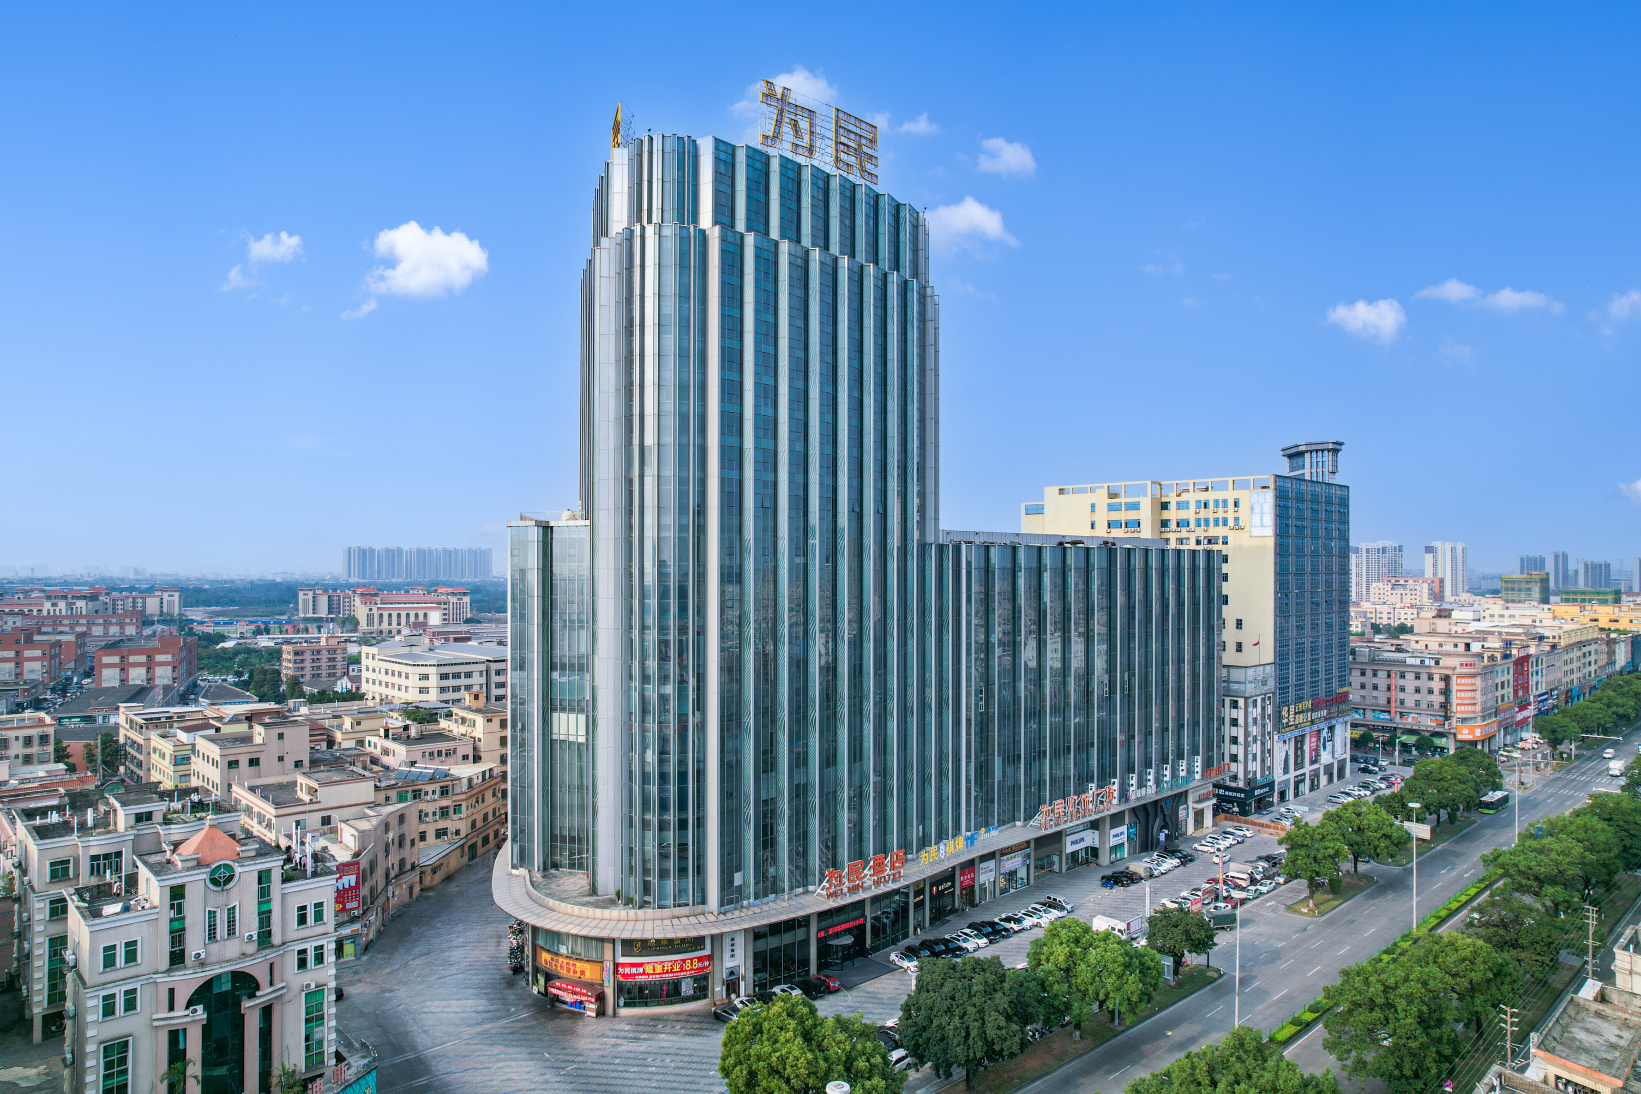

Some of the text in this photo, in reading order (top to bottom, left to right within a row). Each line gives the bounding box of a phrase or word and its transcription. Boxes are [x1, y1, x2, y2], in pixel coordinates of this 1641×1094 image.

[760, 79, 879, 185] 为民
[1203, 762, 1231, 780] H PARTY
[1172, 774, 1191, 789] CLUB
[1040, 785, 1115, 822] 为民灯饰广场
[1041, 821, 1051, 829] WEI
[1053, 817, 1065, 825] MIN
[1070, 836, 1085, 846] PHILIPS
[1112, 831, 1125, 839] PHILIPS
[920, 845, 939, 867] 为民
[825, 849, 905, 891] 为民酒店
[826, 871, 904, 899] WEI MIN HOTEL
[644, 962, 682, 975] 隆重开业
